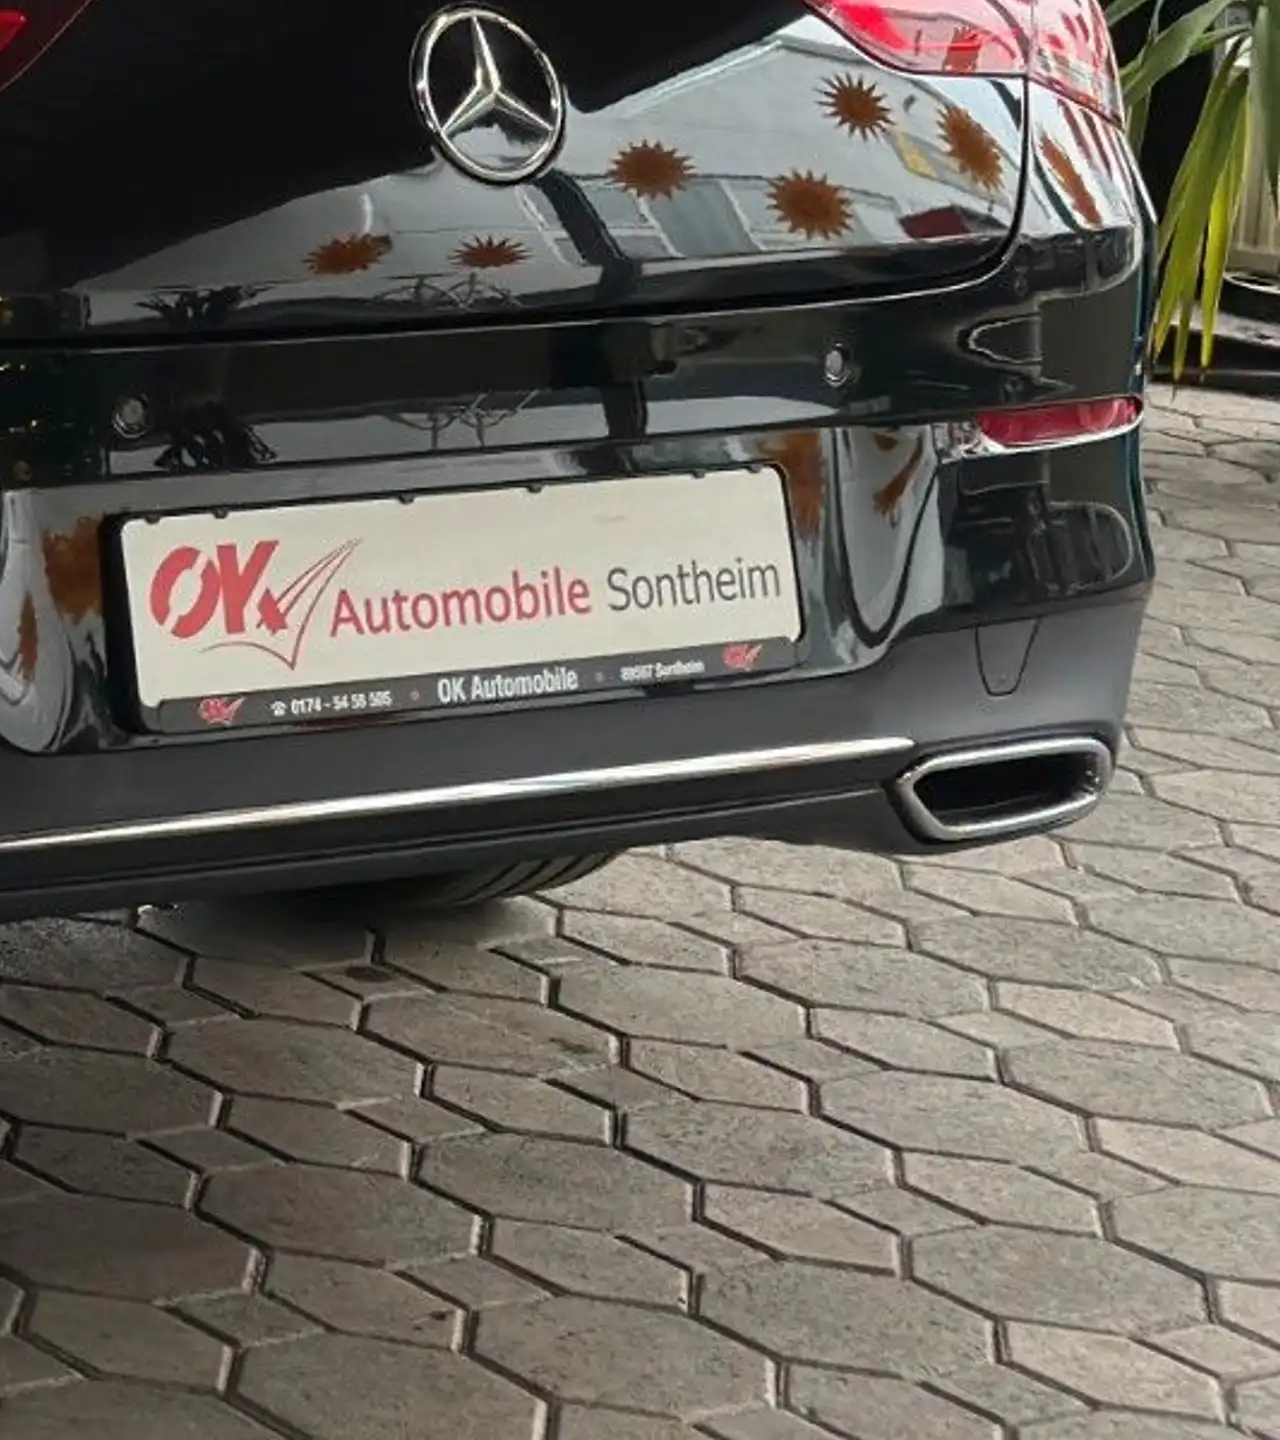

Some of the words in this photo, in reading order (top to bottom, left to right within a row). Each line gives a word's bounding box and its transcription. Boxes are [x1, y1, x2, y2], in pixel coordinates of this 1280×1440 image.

[150, 539, 288, 639] OK
[330, 565, 592, 638] Automobile
[606, 557, 781, 612] Sontheim
[291, 696, 322, 716] 0174
[437, 677, 467, 704] OK
[470, 666, 578, 702] Automobile
